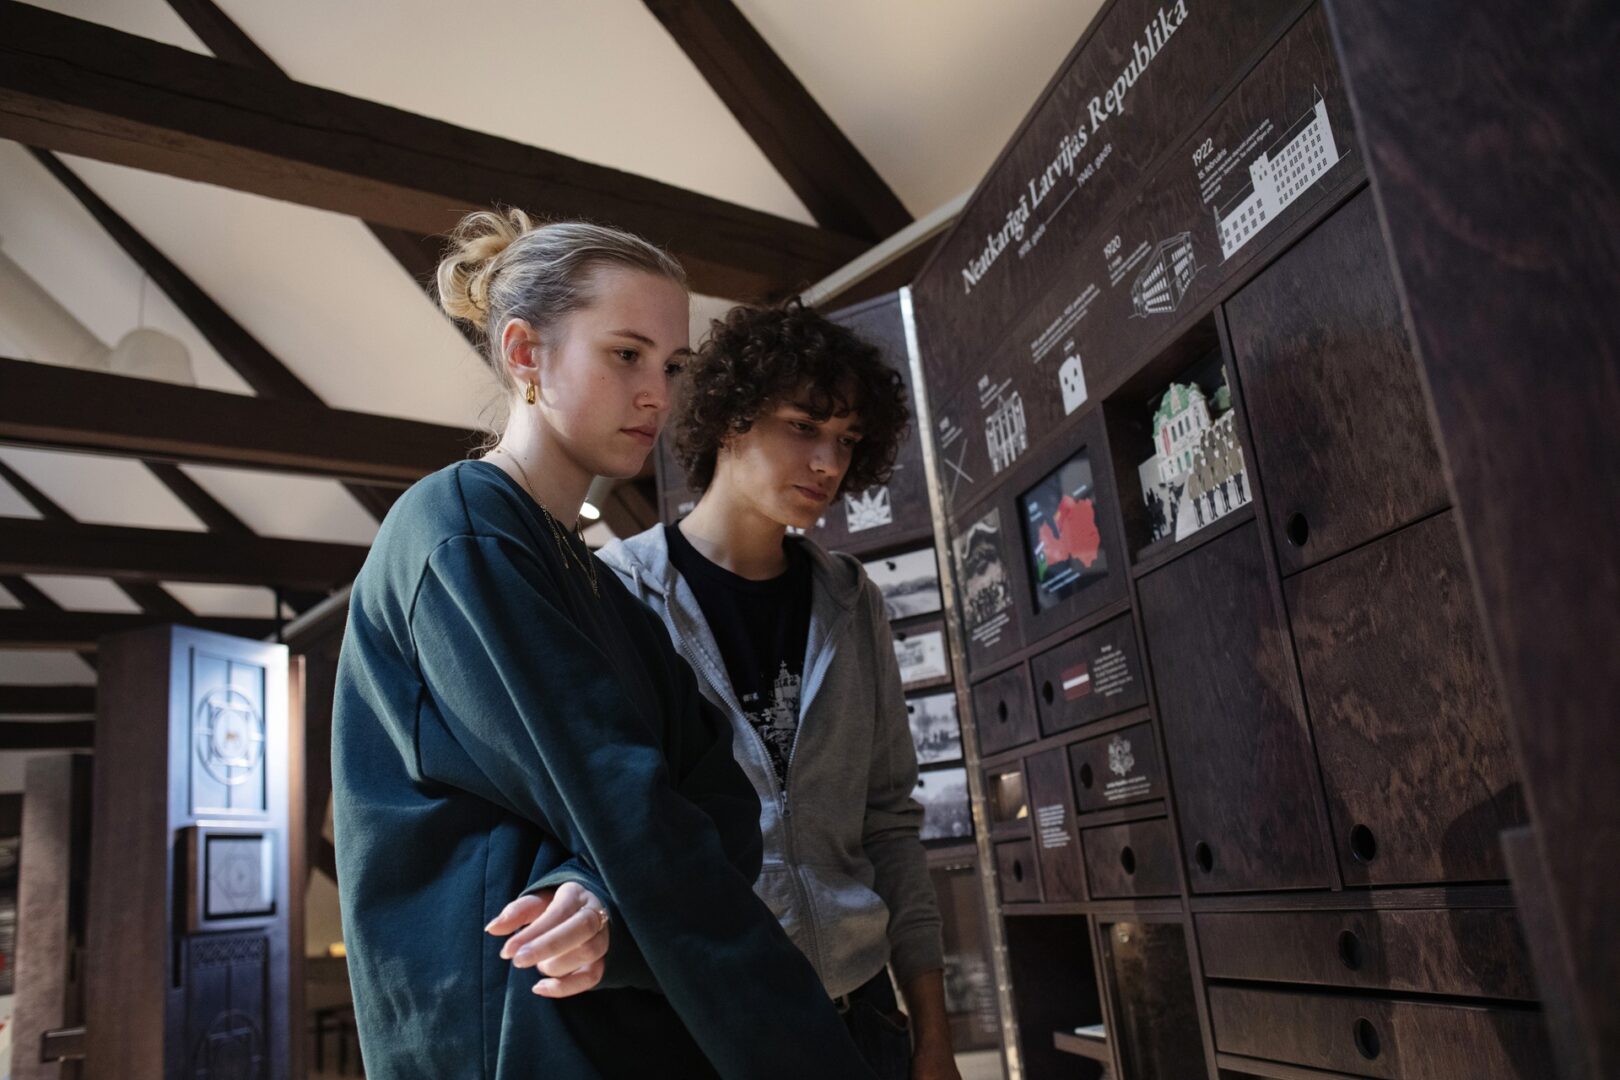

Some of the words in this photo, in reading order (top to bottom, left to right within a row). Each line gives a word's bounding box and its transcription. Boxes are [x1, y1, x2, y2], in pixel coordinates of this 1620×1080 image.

[1087, 0, 1189, 134] Republika
[1192, 137, 1214, 167] 1922
[1103, 234, 1121, 260] 1920
